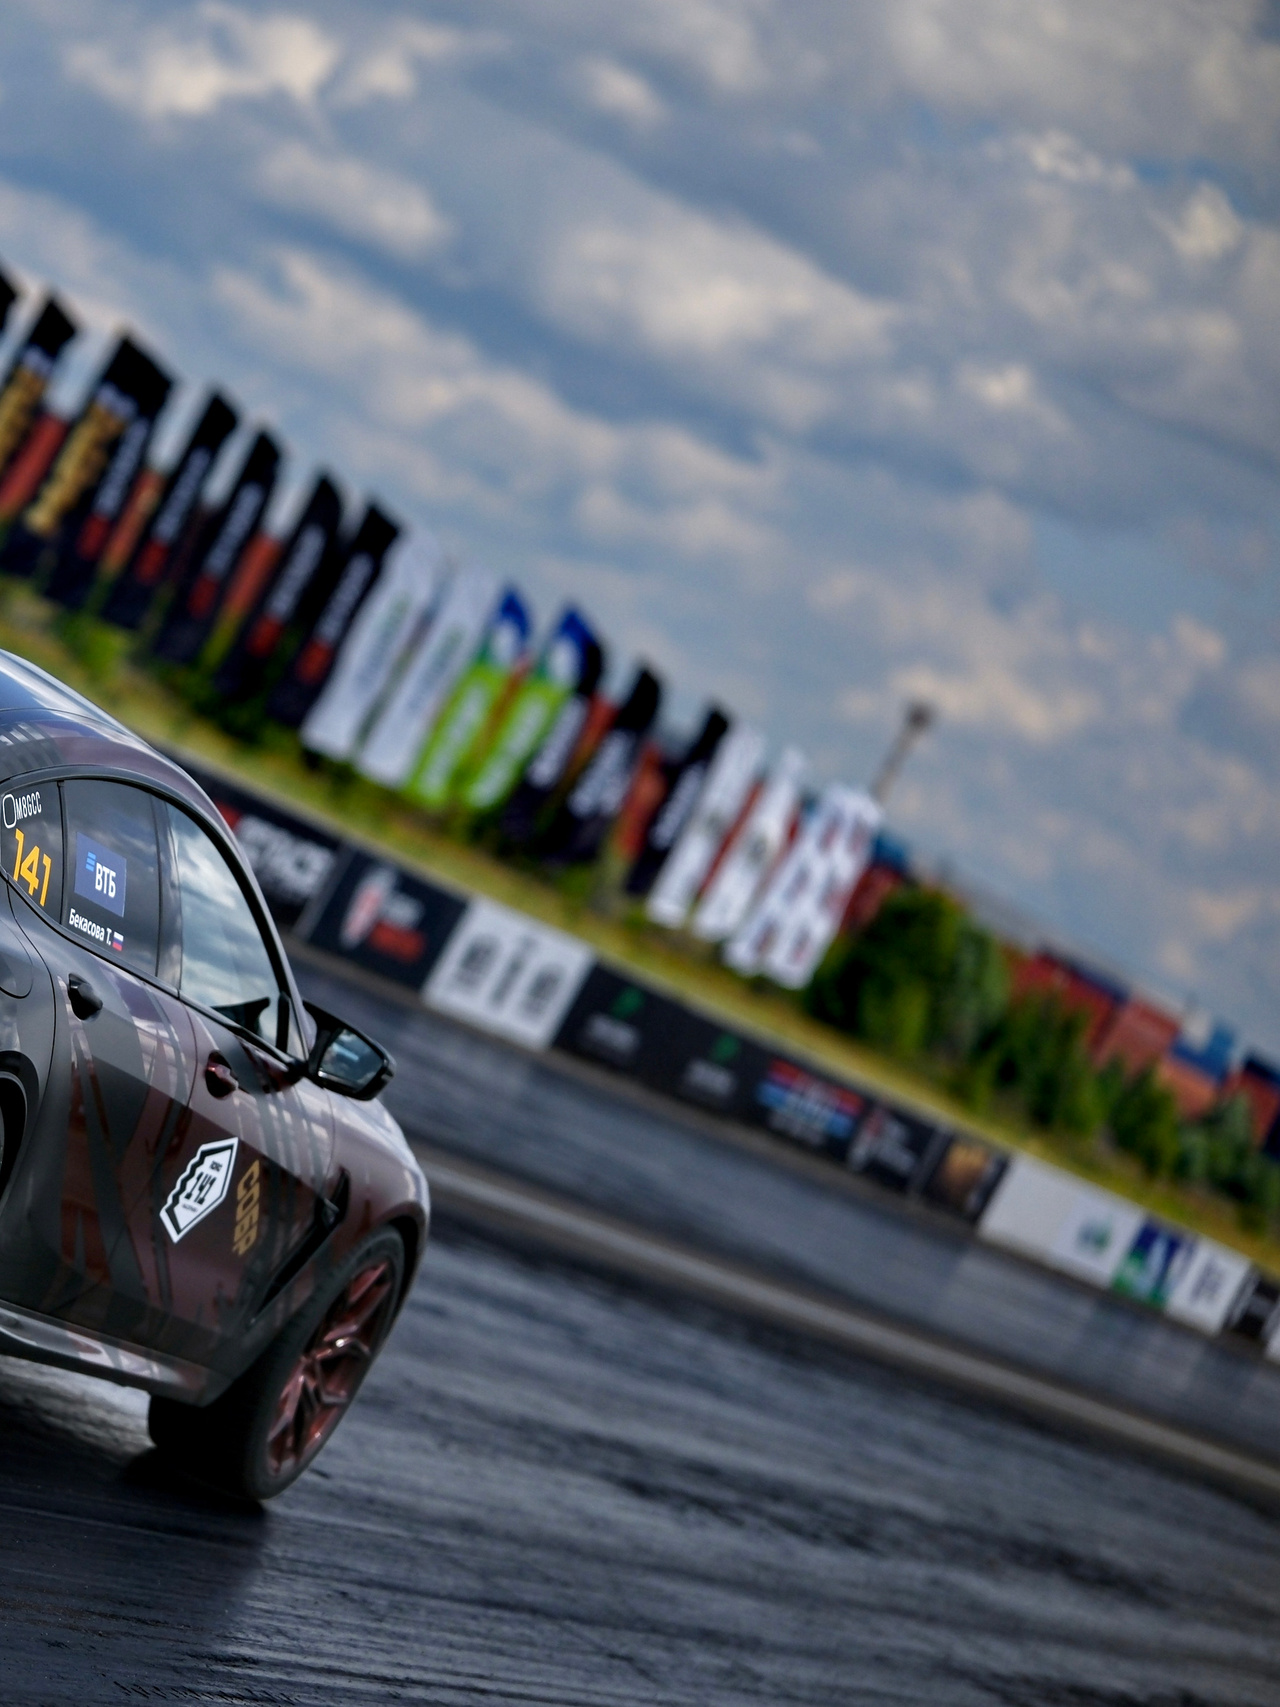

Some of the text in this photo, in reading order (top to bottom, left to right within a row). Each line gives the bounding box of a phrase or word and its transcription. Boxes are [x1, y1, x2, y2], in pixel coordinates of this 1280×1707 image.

[13, 828, 52, 907] 141
[95, 862, 116, 898] ВТБ
[69, 908, 105, 942] Бекасова
[184, 1171, 217, 1205] 141
